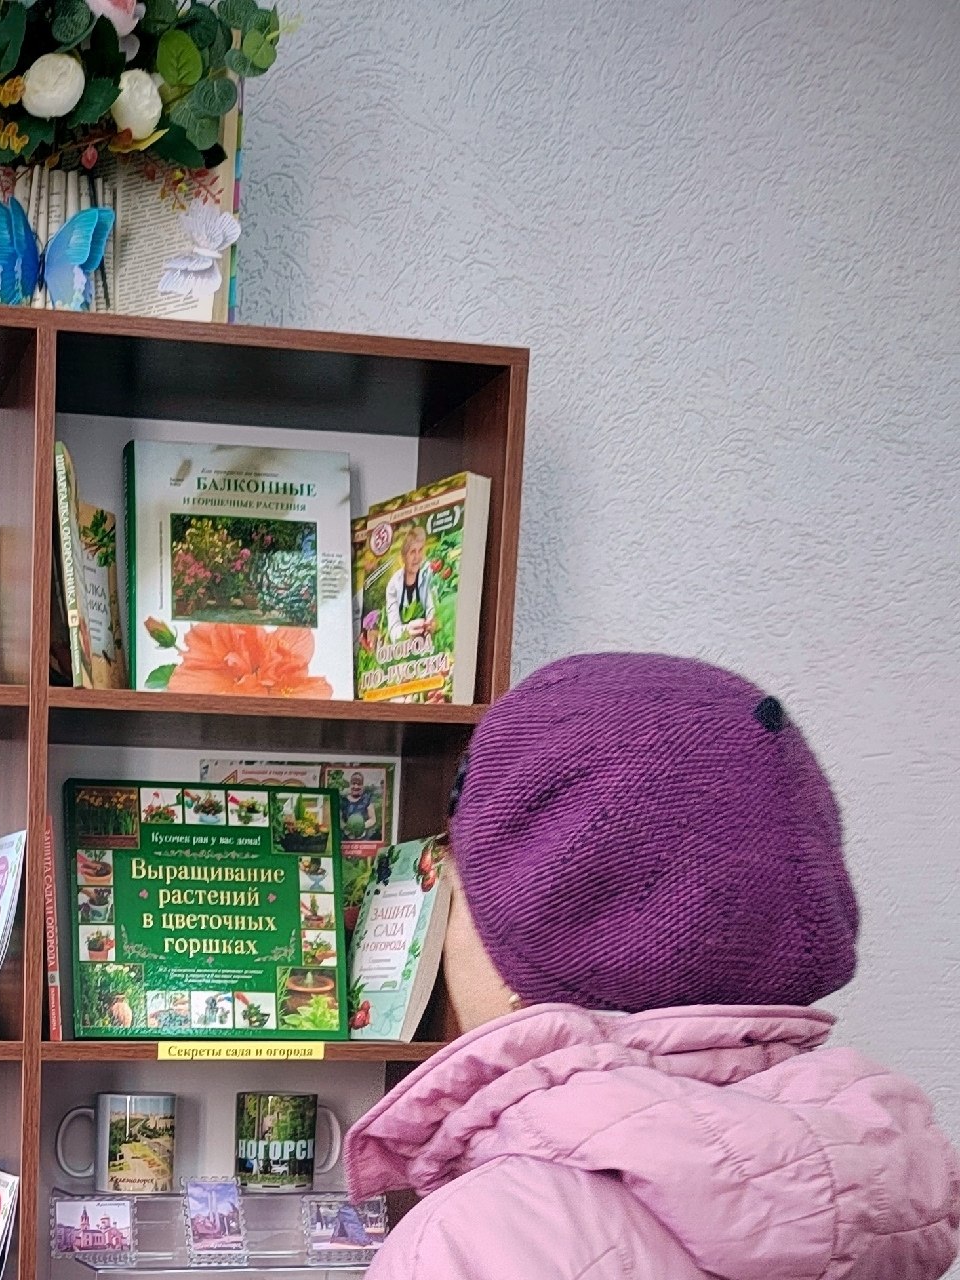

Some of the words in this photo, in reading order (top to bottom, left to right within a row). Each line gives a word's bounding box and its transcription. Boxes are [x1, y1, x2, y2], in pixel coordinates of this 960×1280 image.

[196, 476, 317, 498] БАЛКОННЫЕ
[183, 496, 190, 505] И
[192, 497, 255, 510] ГОРШЕЧНЫЕ
[256, 501, 307, 512] РАСТЕНИЯ
[151, 832, 191, 847] Кусочек
[193, 836, 208, 846] рая
[210, 837, 217, 847] у
[219, 836, 235, 845] вас
[236, 835, 261, 846] дома!
[130, 857, 286, 885] Выращивание
[158, 886, 260, 909] растений
[142, 913, 154, 928] в
[161, 912, 278, 931] цветочных
[373, 922, 404, 938] САДА
[163, 937, 259, 958] горшках
[168, 1045, 221, 1060] Секреты
[225, 1048, 251, 1057] сада
[255, 1048, 262, 1057] и
[266, 1047, 314, 1060] огорода
